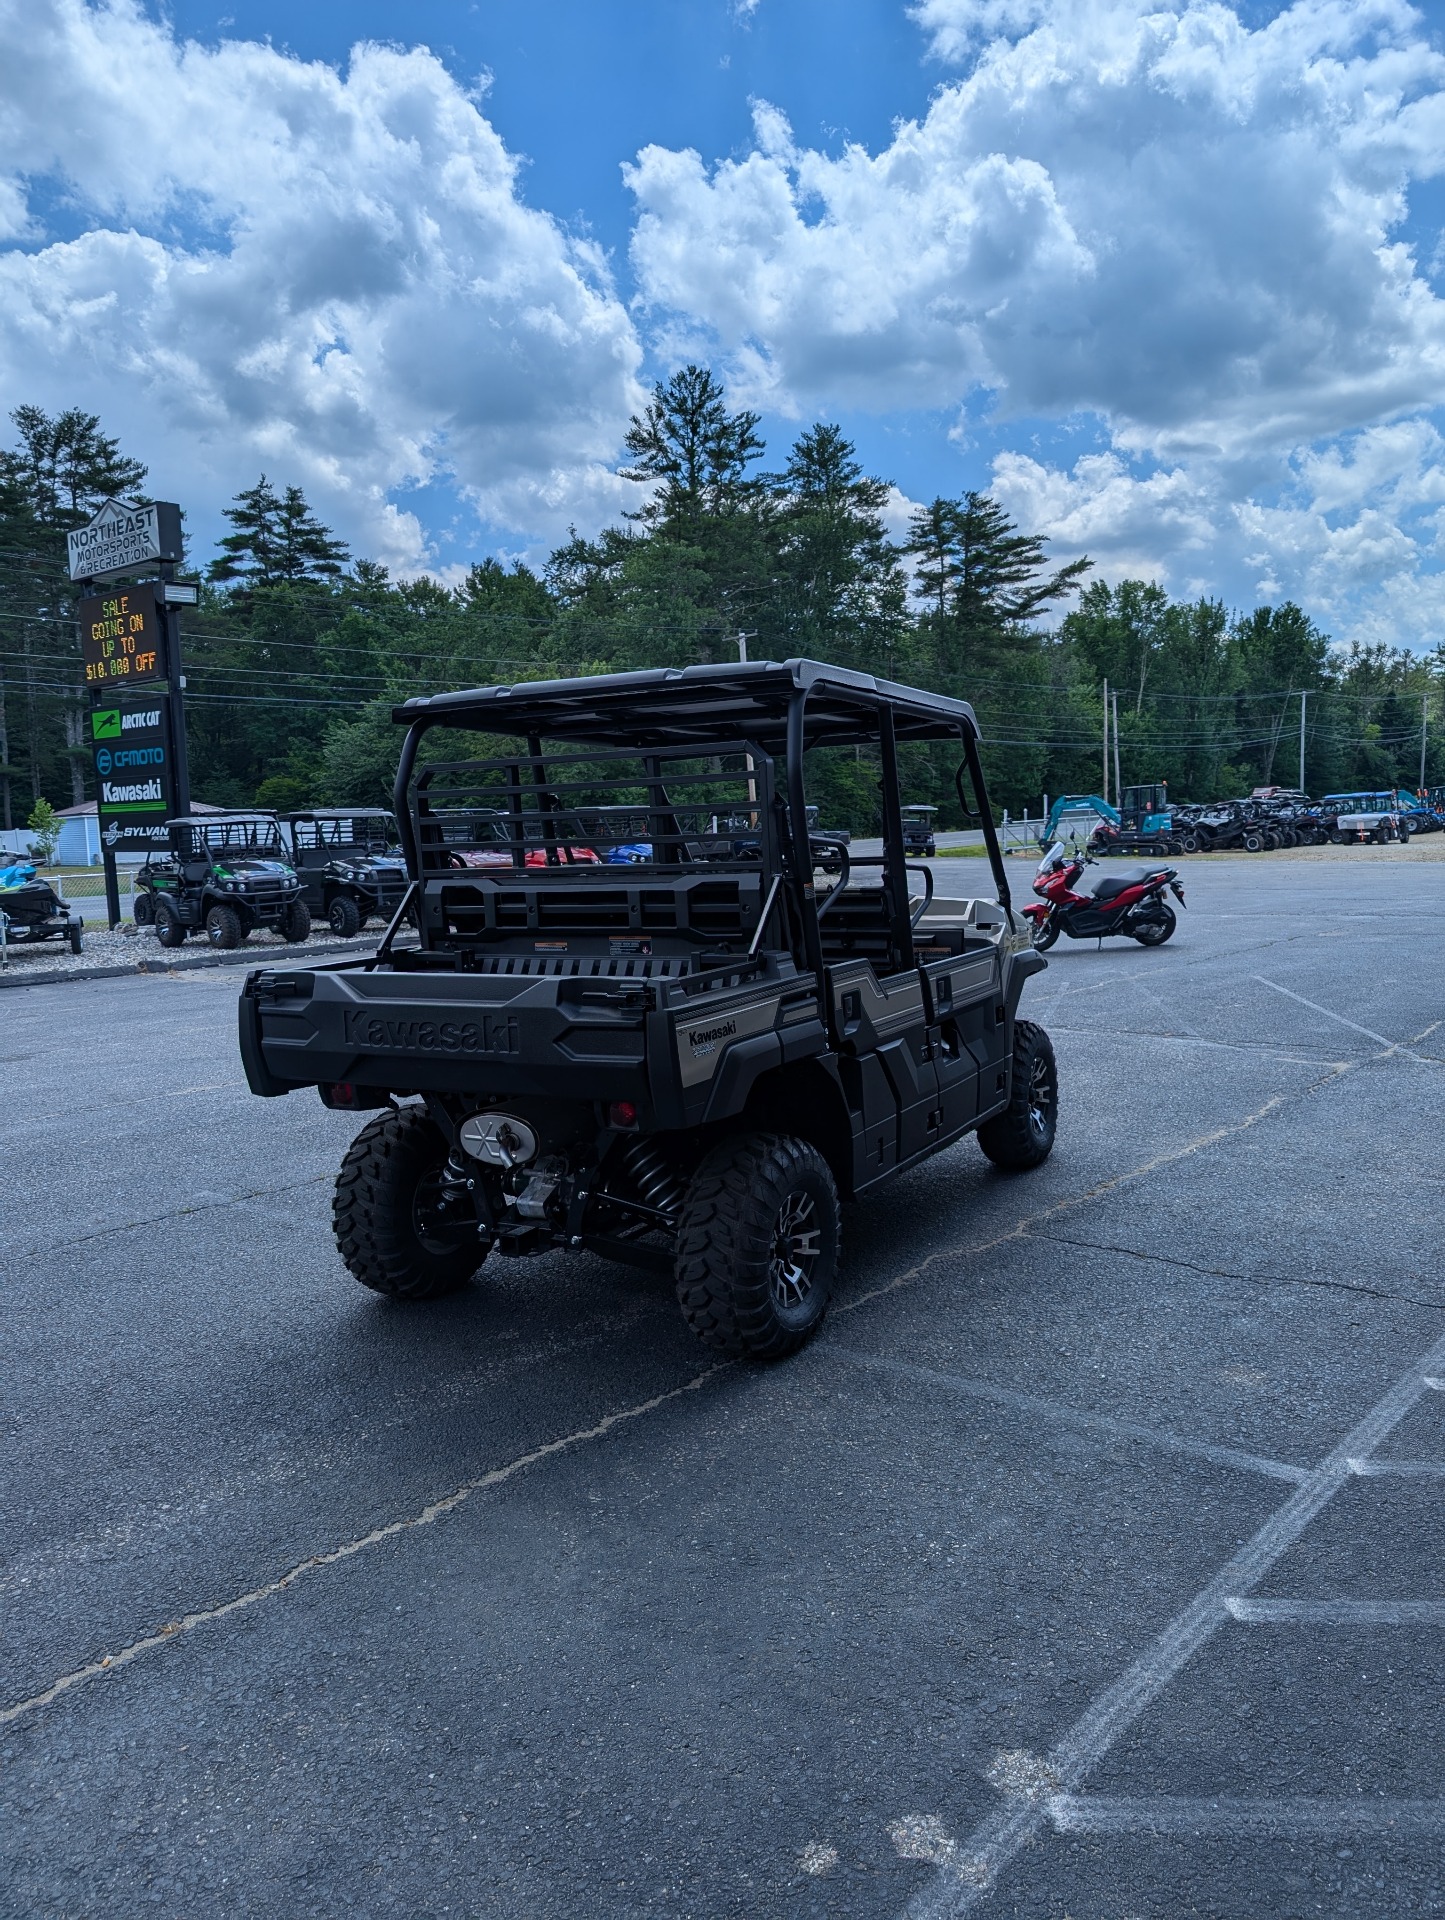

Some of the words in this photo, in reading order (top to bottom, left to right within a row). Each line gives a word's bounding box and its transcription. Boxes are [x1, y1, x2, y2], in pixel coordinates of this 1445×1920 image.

[70, 509, 154, 550] NORTHEAST
[77, 531, 150, 563] MOTORSPORTS
[102, 596, 129, 618] SALE
[91, 617, 124, 640] GOING
[129, 614, 143, 632] ON
[102, 640, 115, 658] UP
[120, 636, 135, 654] TO
[135, 651, 156, 672] OFF
[121, 712, 146, 730] ARCTIC
[146, 710, 161, 727] CAT
[114, 747, 164, 767] CFMOTO
[102, 778, 162, 802] Kawasaki
[123, 826, 169, 837] SYLVAN
[343, 1010, 520, 1055] Kawasaki
[688, 1020, 737, 1047] Kawasaki
